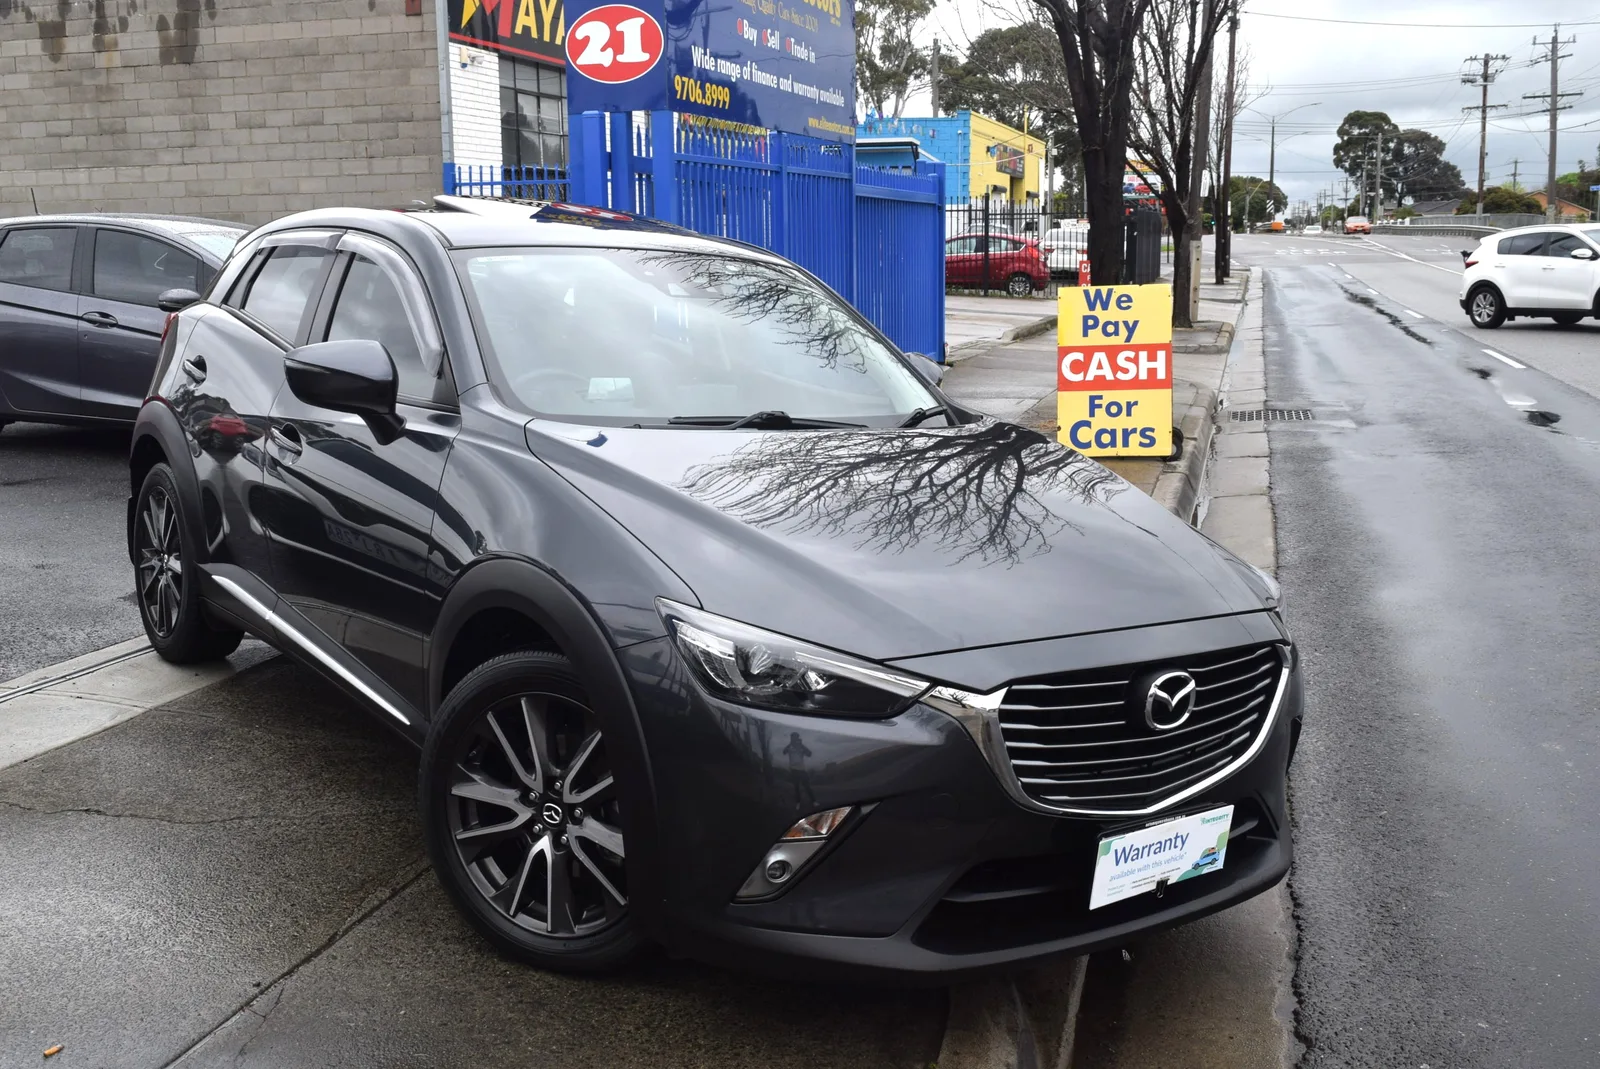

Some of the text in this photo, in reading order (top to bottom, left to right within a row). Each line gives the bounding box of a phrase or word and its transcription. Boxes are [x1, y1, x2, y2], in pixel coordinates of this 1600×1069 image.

[575, 17, 650, 67] 21
[743, 19, 816, 64] Buy Sell Trade in
[674, 74, 730, 110] 9706.8999
[691, 45, 845, 108] Wide range of finance and warranty available
[1083, 288, 1134, 312] We
[1082, 314, 1139, 343] Pay
[1061, 350, 1167, 382] CASH
[1088, 395, 1138, 418] For
[1069, 420, 1157, 449] Cars
[1114, 832, 1190, 867] Warranty
[1109, 867, 1136, 882] available
[1136, 863, 1151, 873] with
[1151, 859, 1163, 869] this
